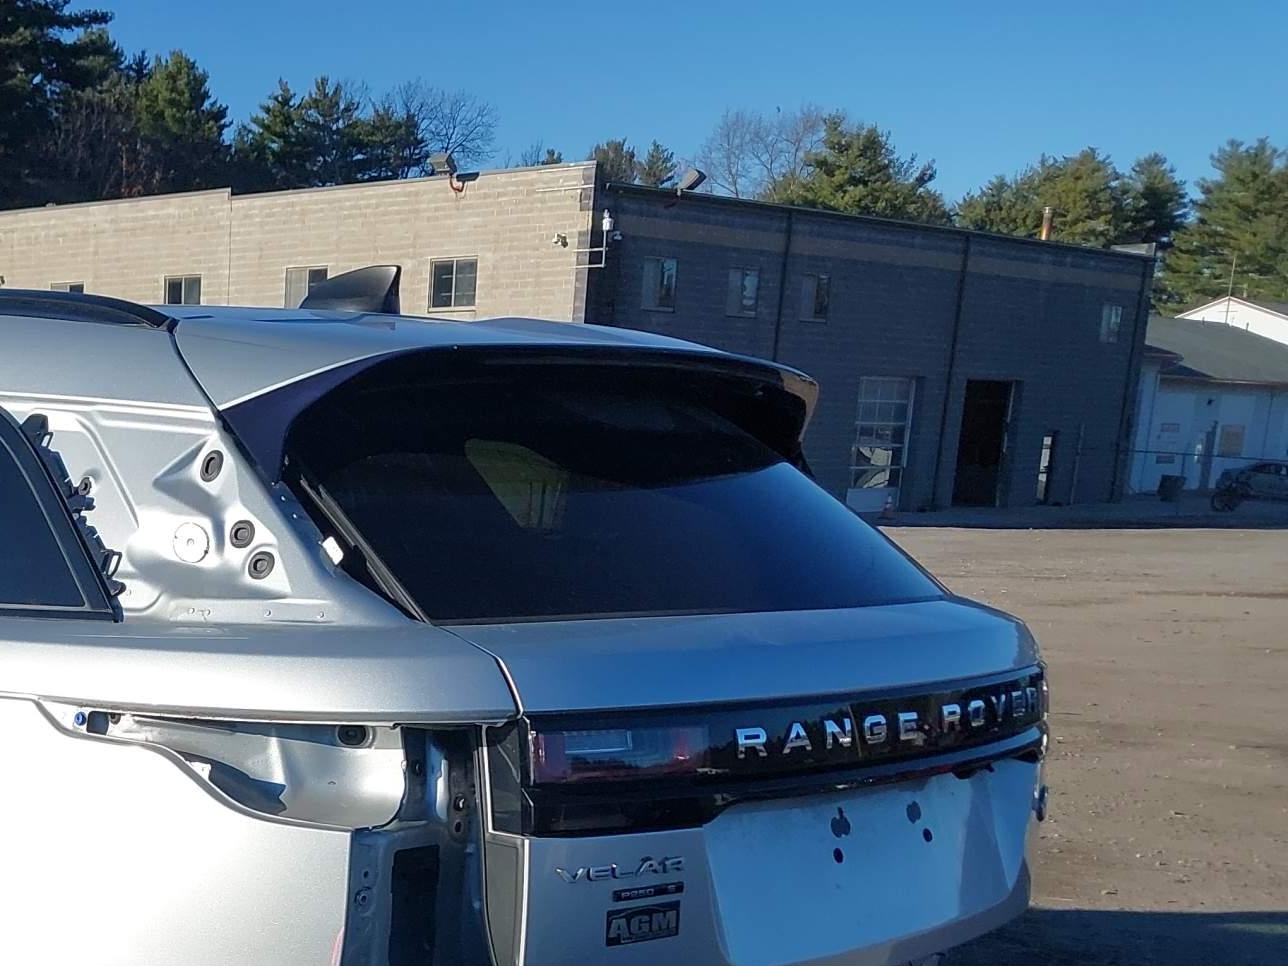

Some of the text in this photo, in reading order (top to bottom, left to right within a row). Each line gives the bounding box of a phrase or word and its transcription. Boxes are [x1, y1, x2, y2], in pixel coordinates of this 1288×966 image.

[734, 687, 1038, 760] RANGE ROVER
[554, 855, 684, 884] VELAR
[607, 910, 679, 940] AGM
